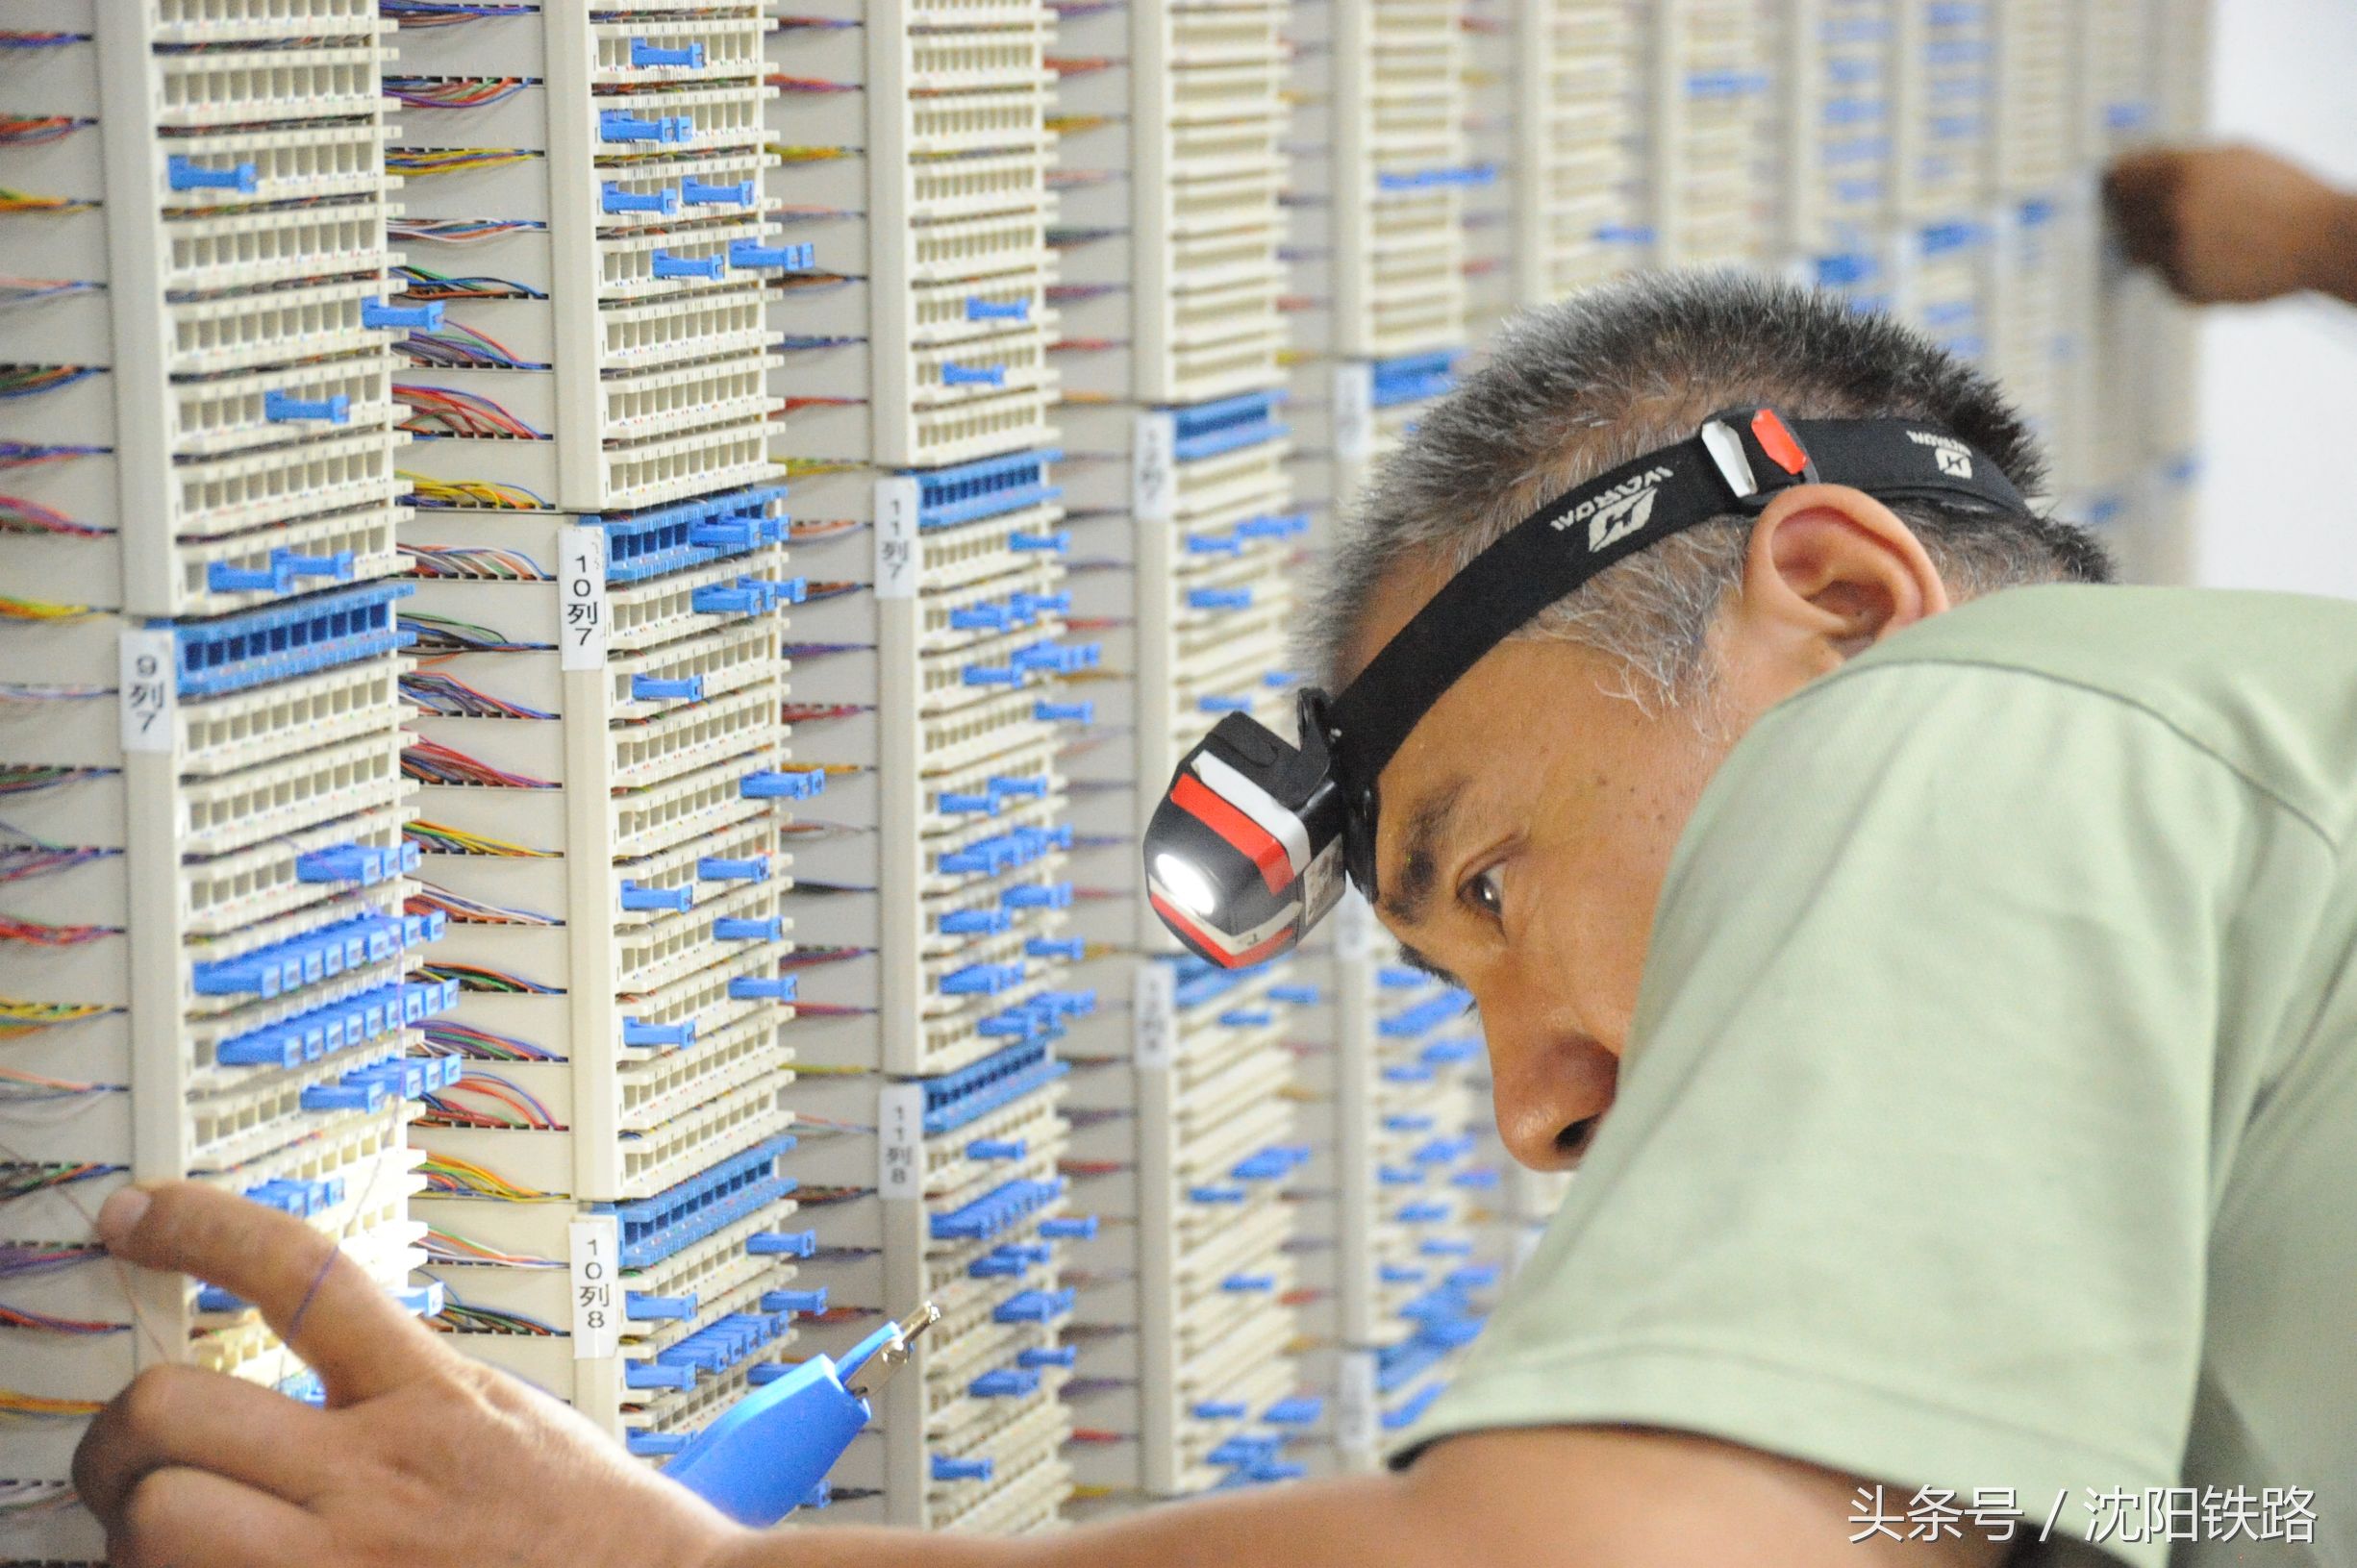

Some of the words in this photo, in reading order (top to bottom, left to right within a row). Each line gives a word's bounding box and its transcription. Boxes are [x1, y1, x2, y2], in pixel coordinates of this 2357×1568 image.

[882, 498, 909, 581] 11列7
[567, 555, 598, 647] 10列7
[129, 655, 164, 734] 9列7
[579, 1238, 610, 1329] 10列8
